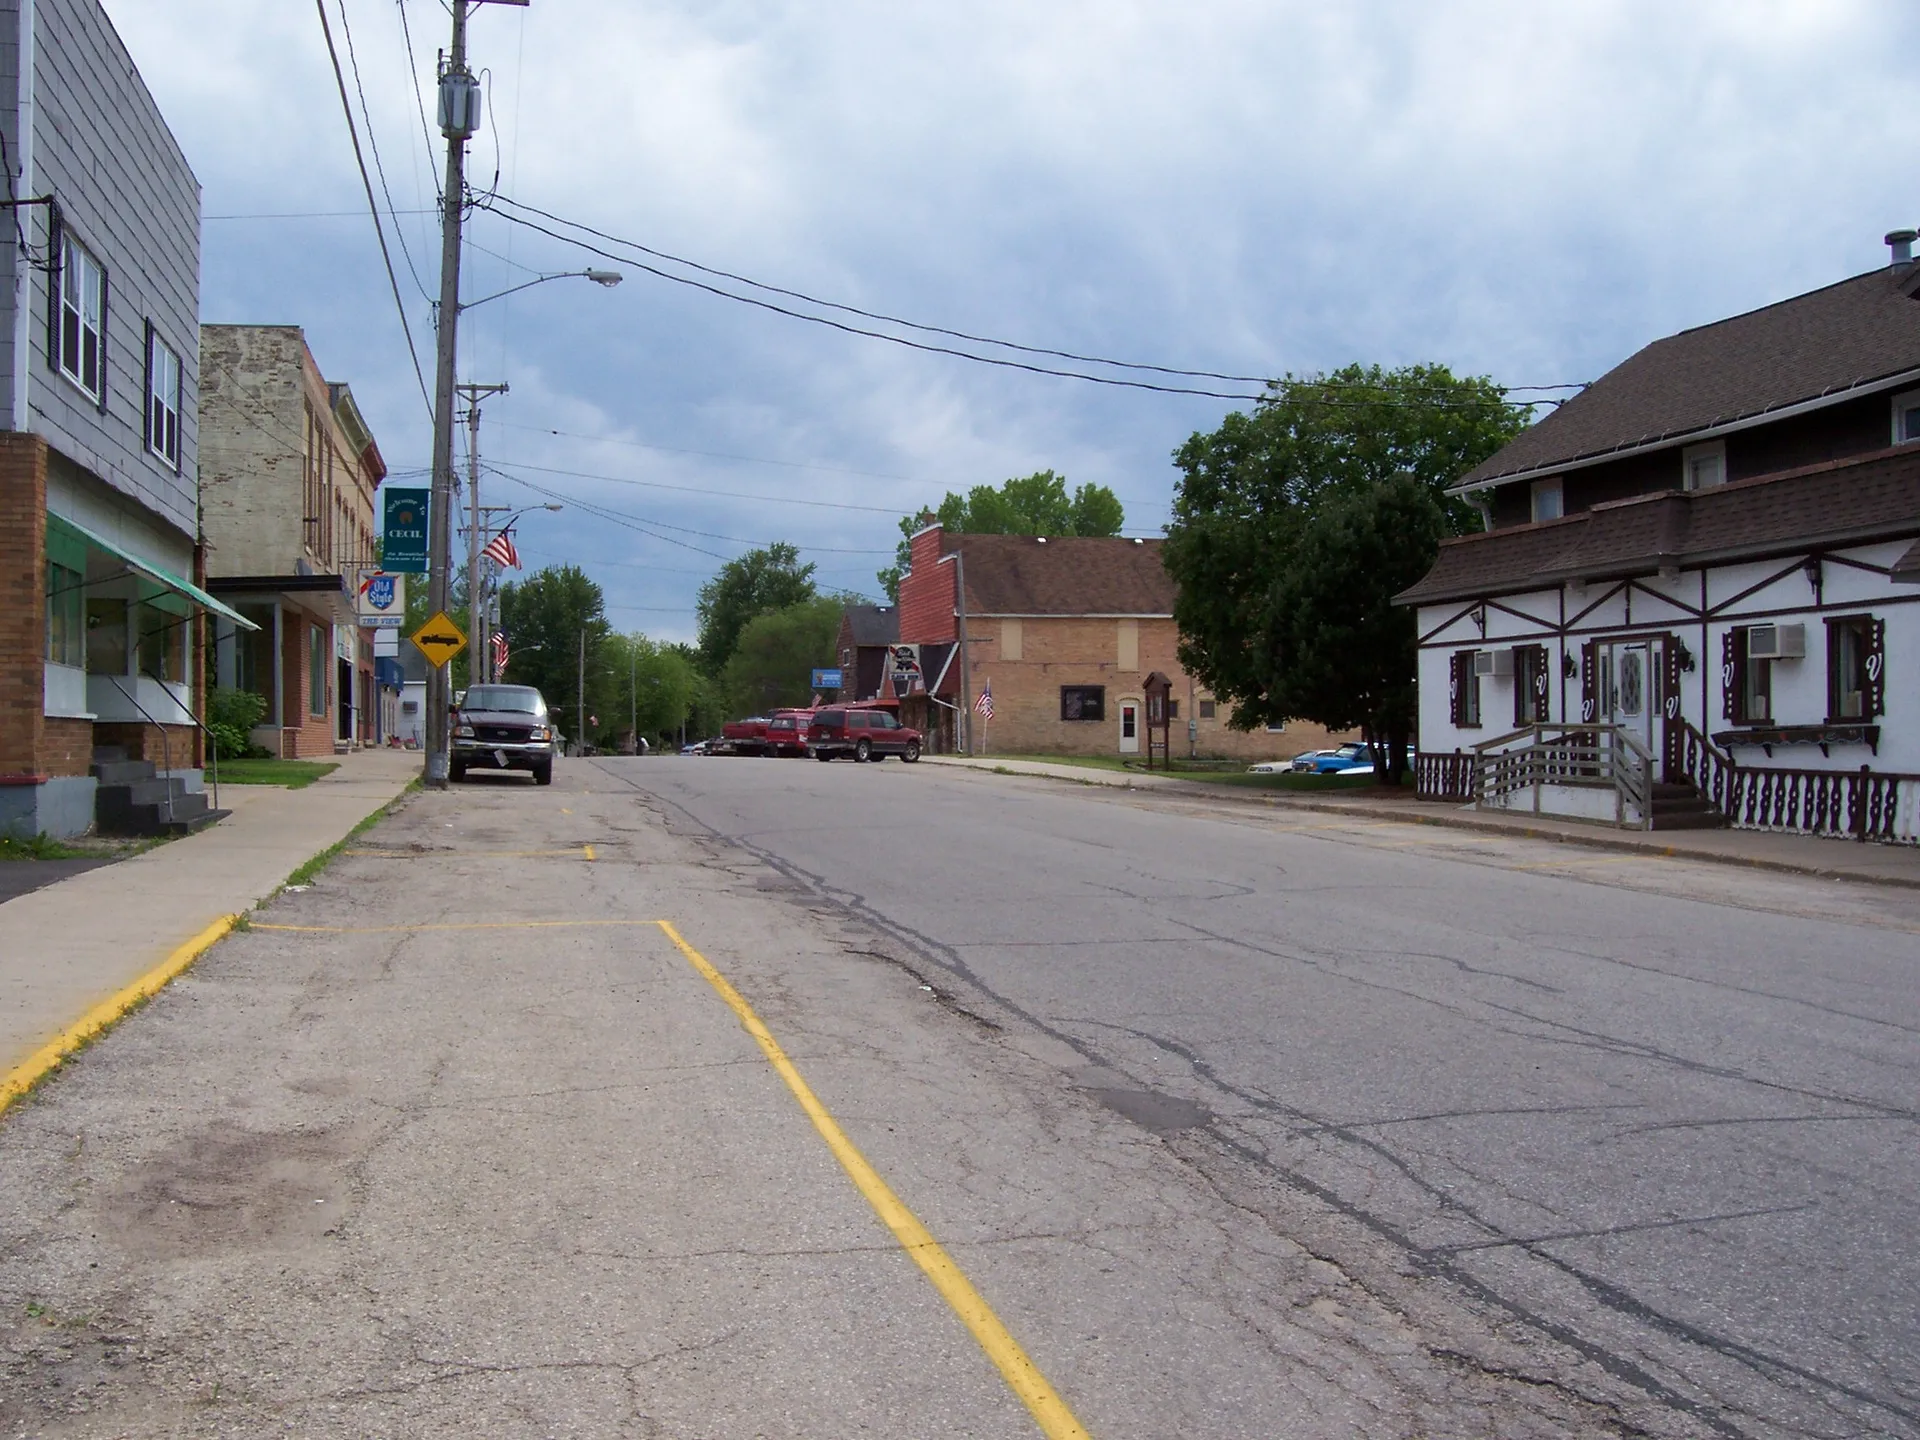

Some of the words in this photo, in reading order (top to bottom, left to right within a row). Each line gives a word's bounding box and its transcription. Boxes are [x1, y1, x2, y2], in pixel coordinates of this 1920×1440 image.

[389, 529, 423, 538] CECIL
[374, 580, 390, 592] Old
[370, 591, 393, 608] Style
